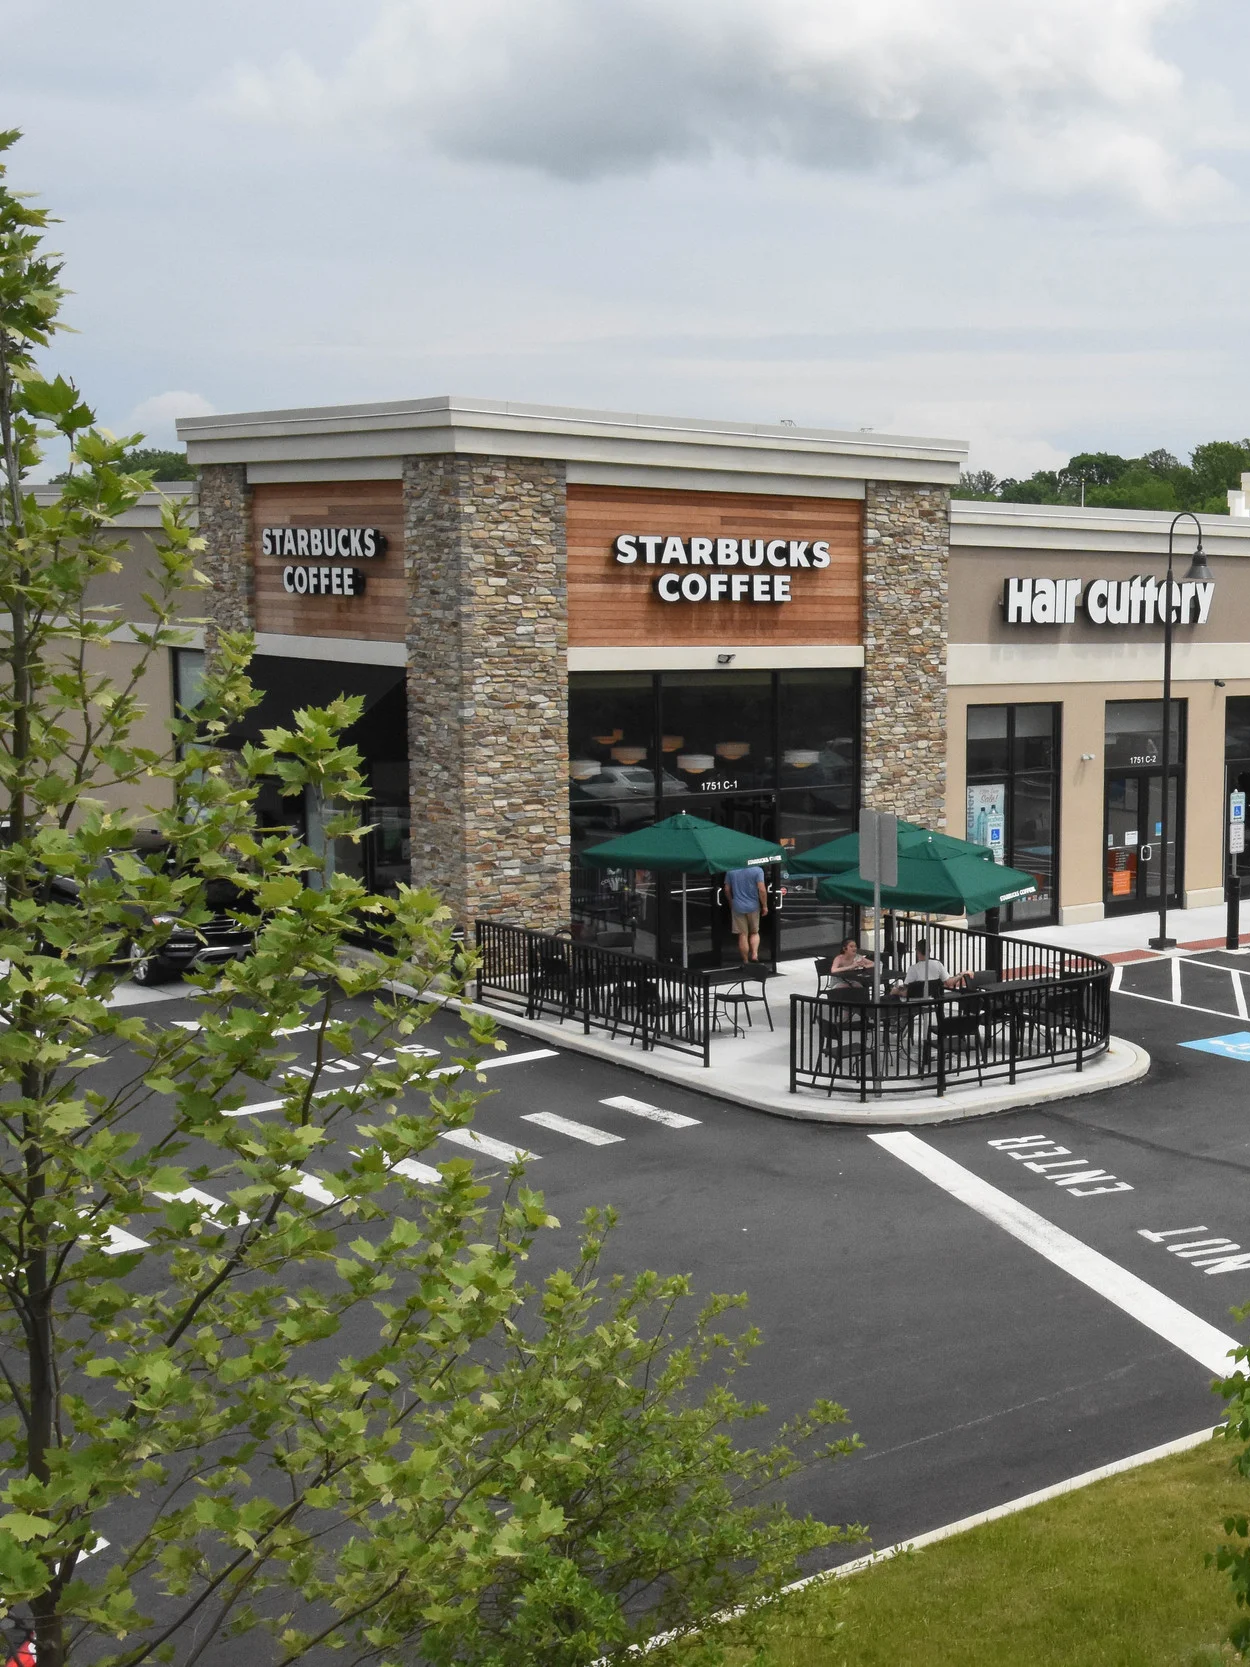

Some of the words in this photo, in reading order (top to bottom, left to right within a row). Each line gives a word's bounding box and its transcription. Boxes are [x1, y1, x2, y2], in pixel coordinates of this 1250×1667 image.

[262, 527, 376, 557] STARBUCKS
[616, 534, 832, 568] STARBUCKS
[283, 565, 355, 595] COFFEE
[658, 573, 792, 602] COFFEE
[1145, 755, 1157, 763] C-2
[701, 781, 721, 791] 1751
[723, 780, 738, 790] C-1
[987, 1134, 1135, 1197] ENTER
